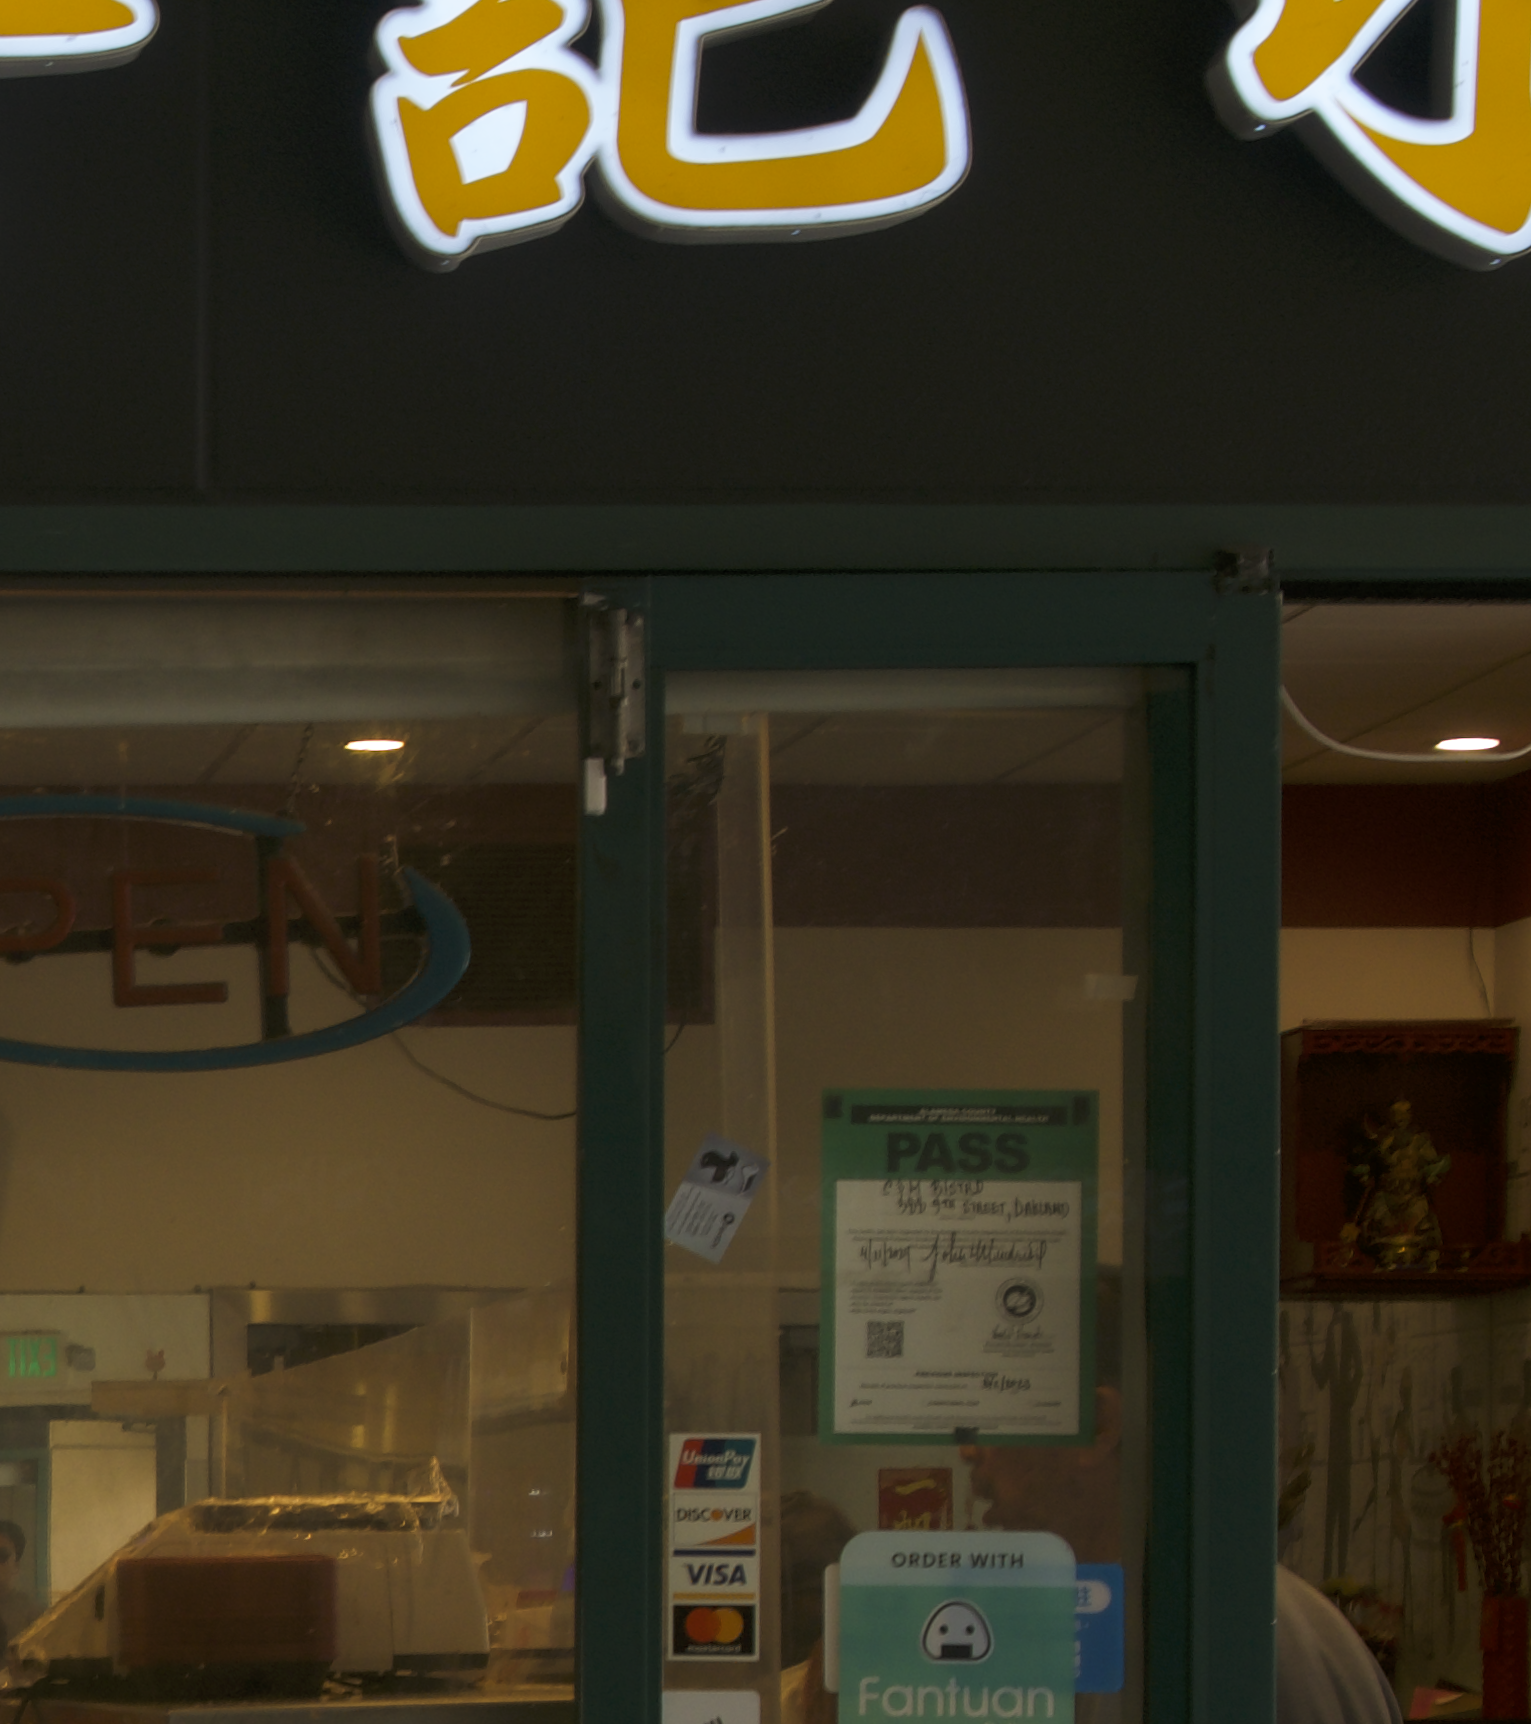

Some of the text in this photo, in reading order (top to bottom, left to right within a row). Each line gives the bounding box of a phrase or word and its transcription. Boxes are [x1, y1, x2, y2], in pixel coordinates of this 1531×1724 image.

[886, 1131, 1031, 1175] PASS
[681, 1449, 751, 1468] UnionPay
[676, 1507, 753, 1523] DISCOVER
[891, 1552, 1024, 1569] ORDER WITH
[683, 1563, 748, 1586] VISA
[858, 1675, 1055, 1718] Fantuan
